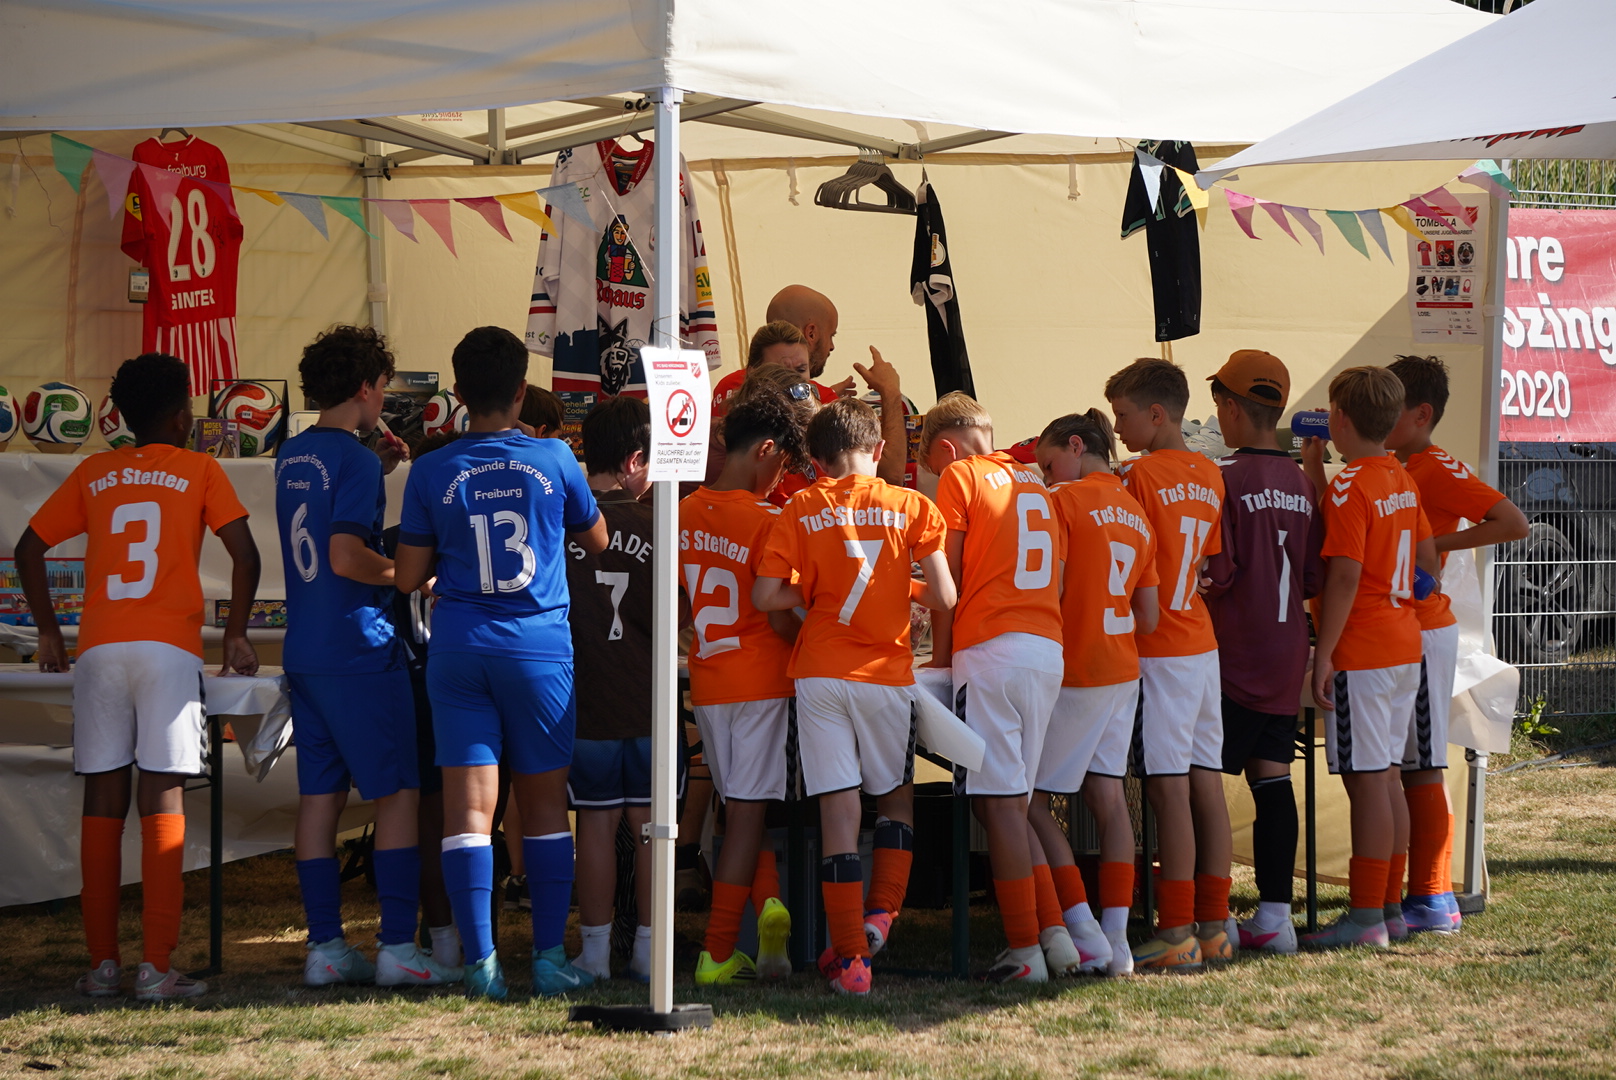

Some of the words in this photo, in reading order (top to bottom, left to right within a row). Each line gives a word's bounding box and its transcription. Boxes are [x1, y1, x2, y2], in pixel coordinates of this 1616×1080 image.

[161, 188, 216, 282] 28
[1415, 218, 1457, 228] TOMBA
[1501, 369, 1571, 418] 2020
[88, 470, 118, 497] TuS
[121, 467, 190, 493] Stetten
[443, 460, 506, 505] Sportfreunde
[509, 459, 554, 495] Eintracht
[474, 488, 523, 501] Freiburg
[1157, 482, 1185, 506] TuS
[1241, 487, 1272, 513] TuS
[799, 510, 836, 535] TuS
[834, 505, 906, 530] Stetten
[1089, 505, 1114, 527] TuS
[106, 501, 161, 600] 3
[290, 502, 319, 583] 6
[469, 510, 537, 594] 13
[567, 530, 653, 563] SADE
[693, 529, 750, 564] Stetten
[1013, 492, 1052, 590] 6
[837, 538, 884, 626] 7
[1278, 529, 1291, 623] 1
[594, 569, 630, 641] 7
[683, 563, 742, 660] 12
